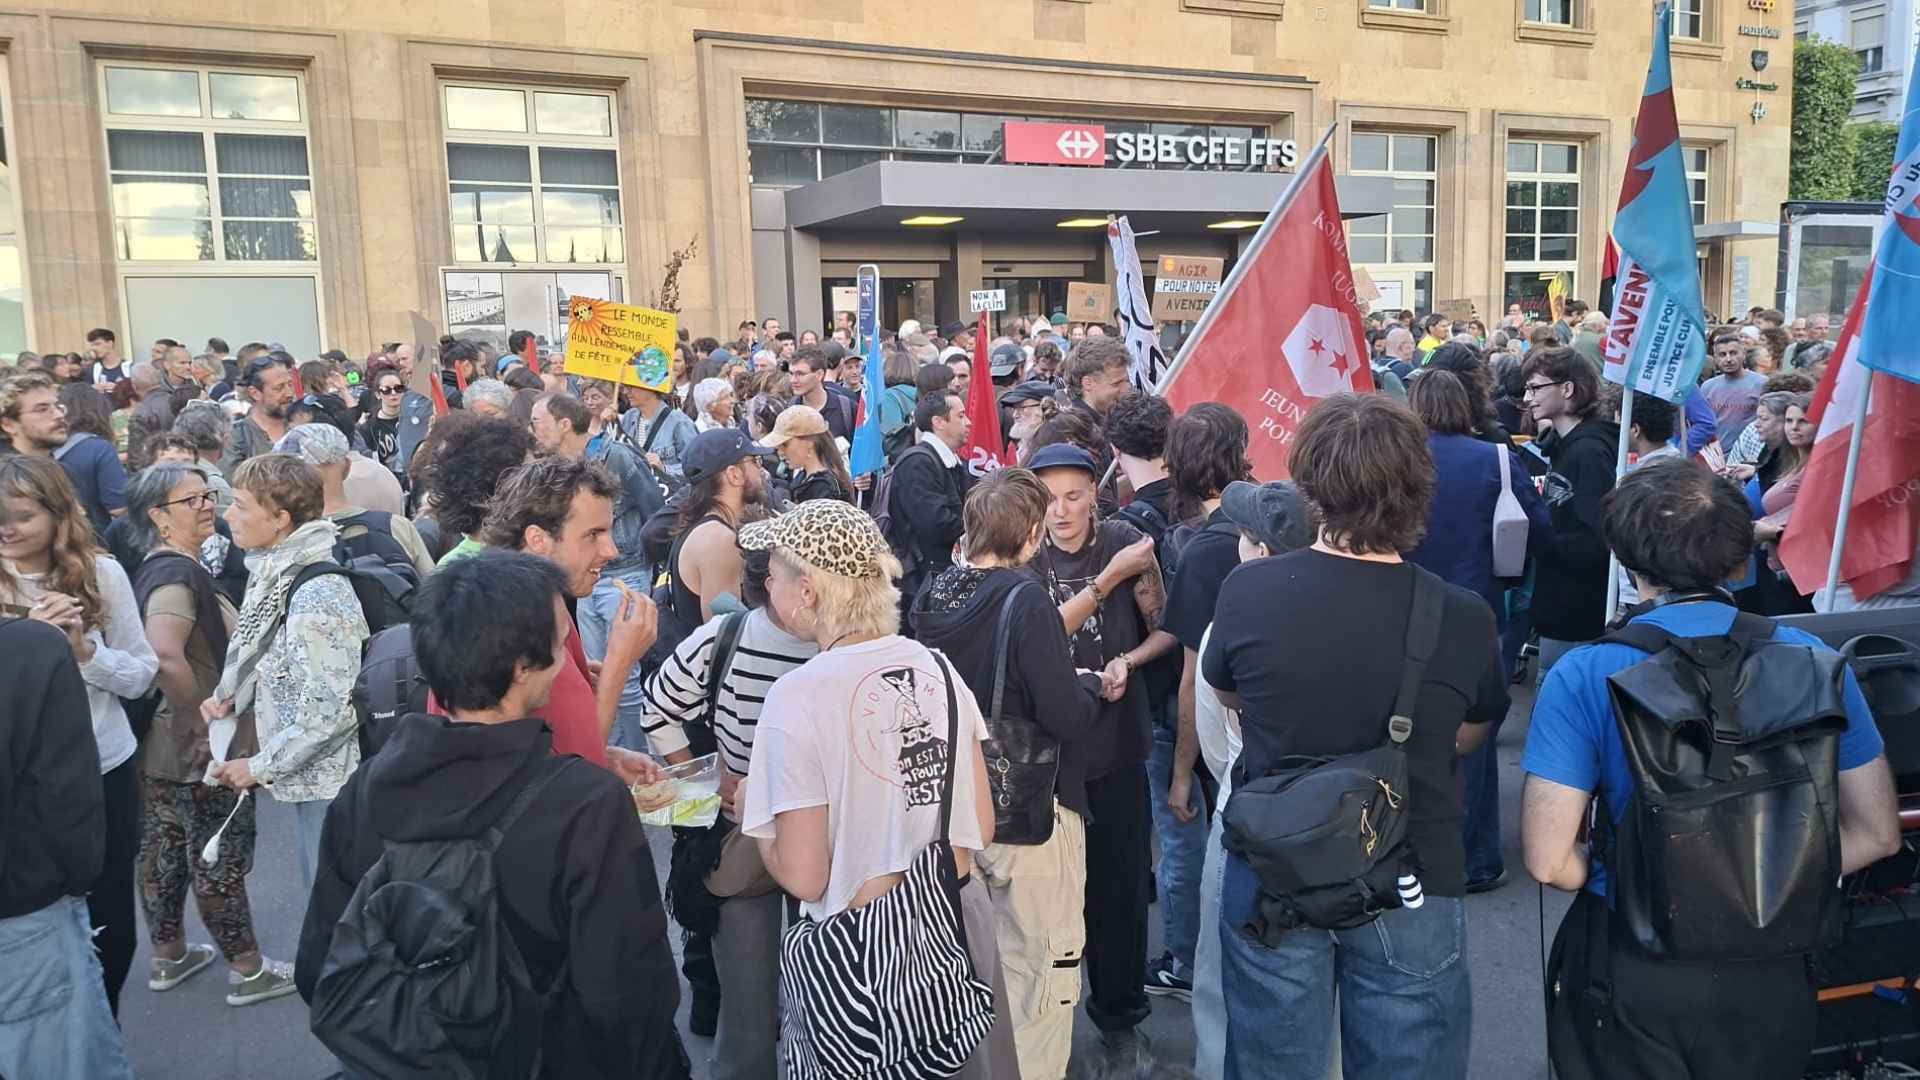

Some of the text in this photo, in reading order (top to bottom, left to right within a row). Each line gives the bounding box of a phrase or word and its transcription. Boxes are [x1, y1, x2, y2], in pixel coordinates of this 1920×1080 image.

[1116, 132, 1177, 163] SBB
[1250, 137, 1297, 167] FFS
[1178, 263, 1208, 278] AGIR
[1163, 279, 1217, 293] POUR NOTRE
[613, 308, 669, 329] LE MONDE
[600, 323, 653, 341] RESSEMBLE
[574, 350, 586, 360] DE
[1642, 322, 1669, 381] ENSEMBLE
[1664, 342, 1685, 388] JUSTICE
[916, 748, 934, 766] EST
